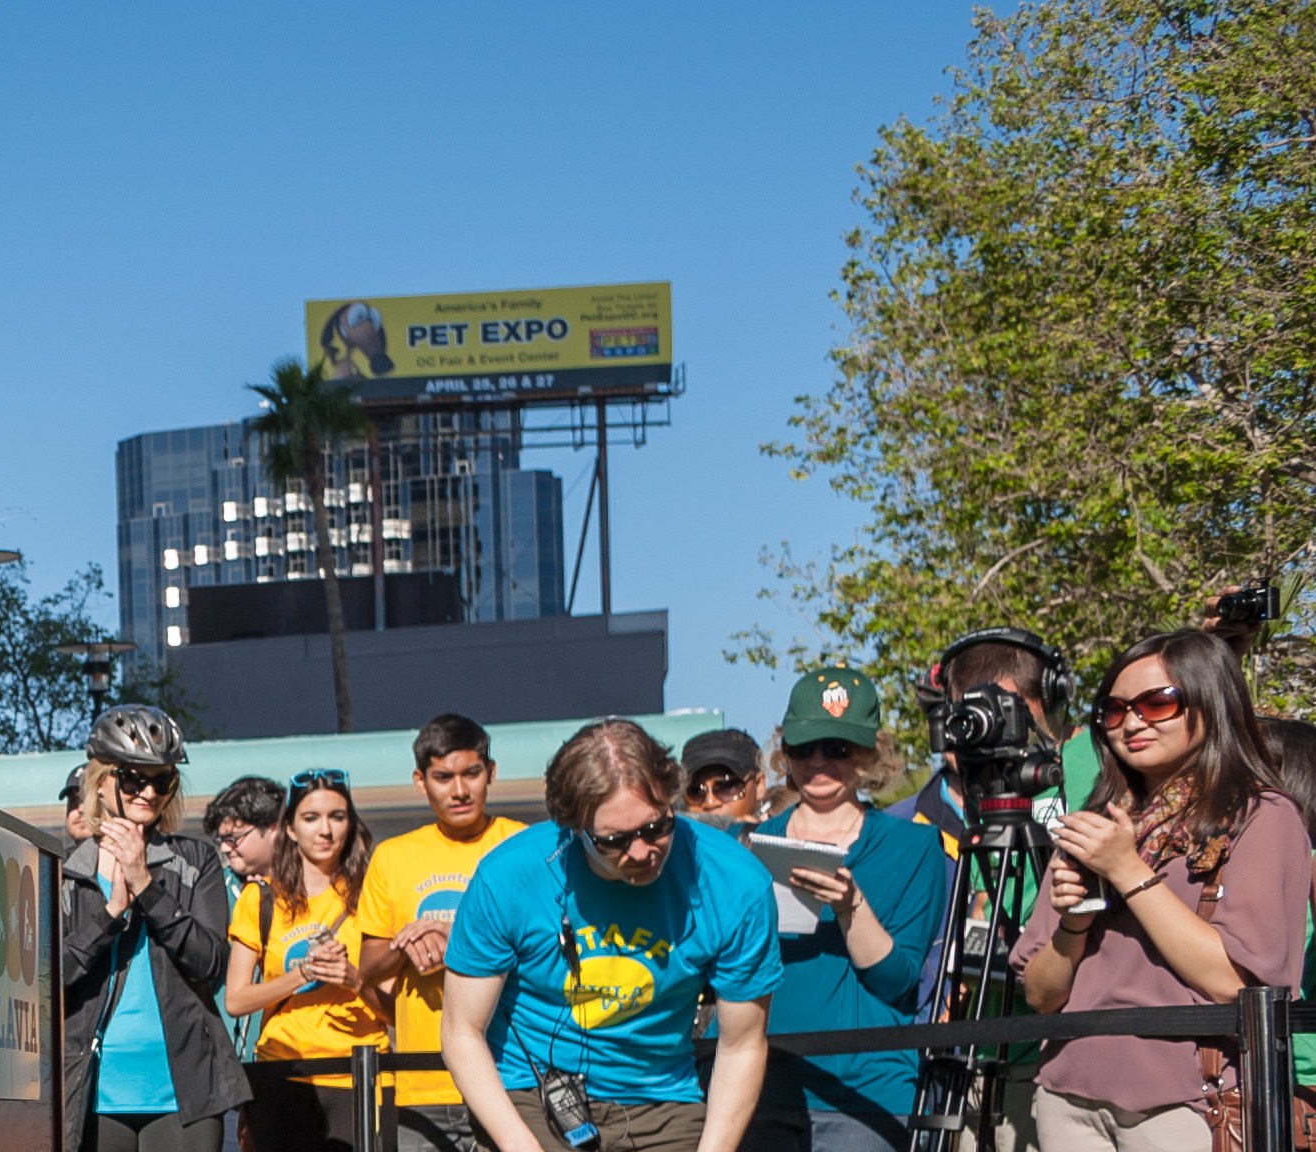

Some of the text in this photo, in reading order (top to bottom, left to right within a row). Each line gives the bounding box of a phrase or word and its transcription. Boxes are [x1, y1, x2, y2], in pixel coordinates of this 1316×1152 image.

[407, 317, 570, 349] PET EXPO
[424, 378, 469, 394] APRIL
[575, 923, 674, 960] TAFF
